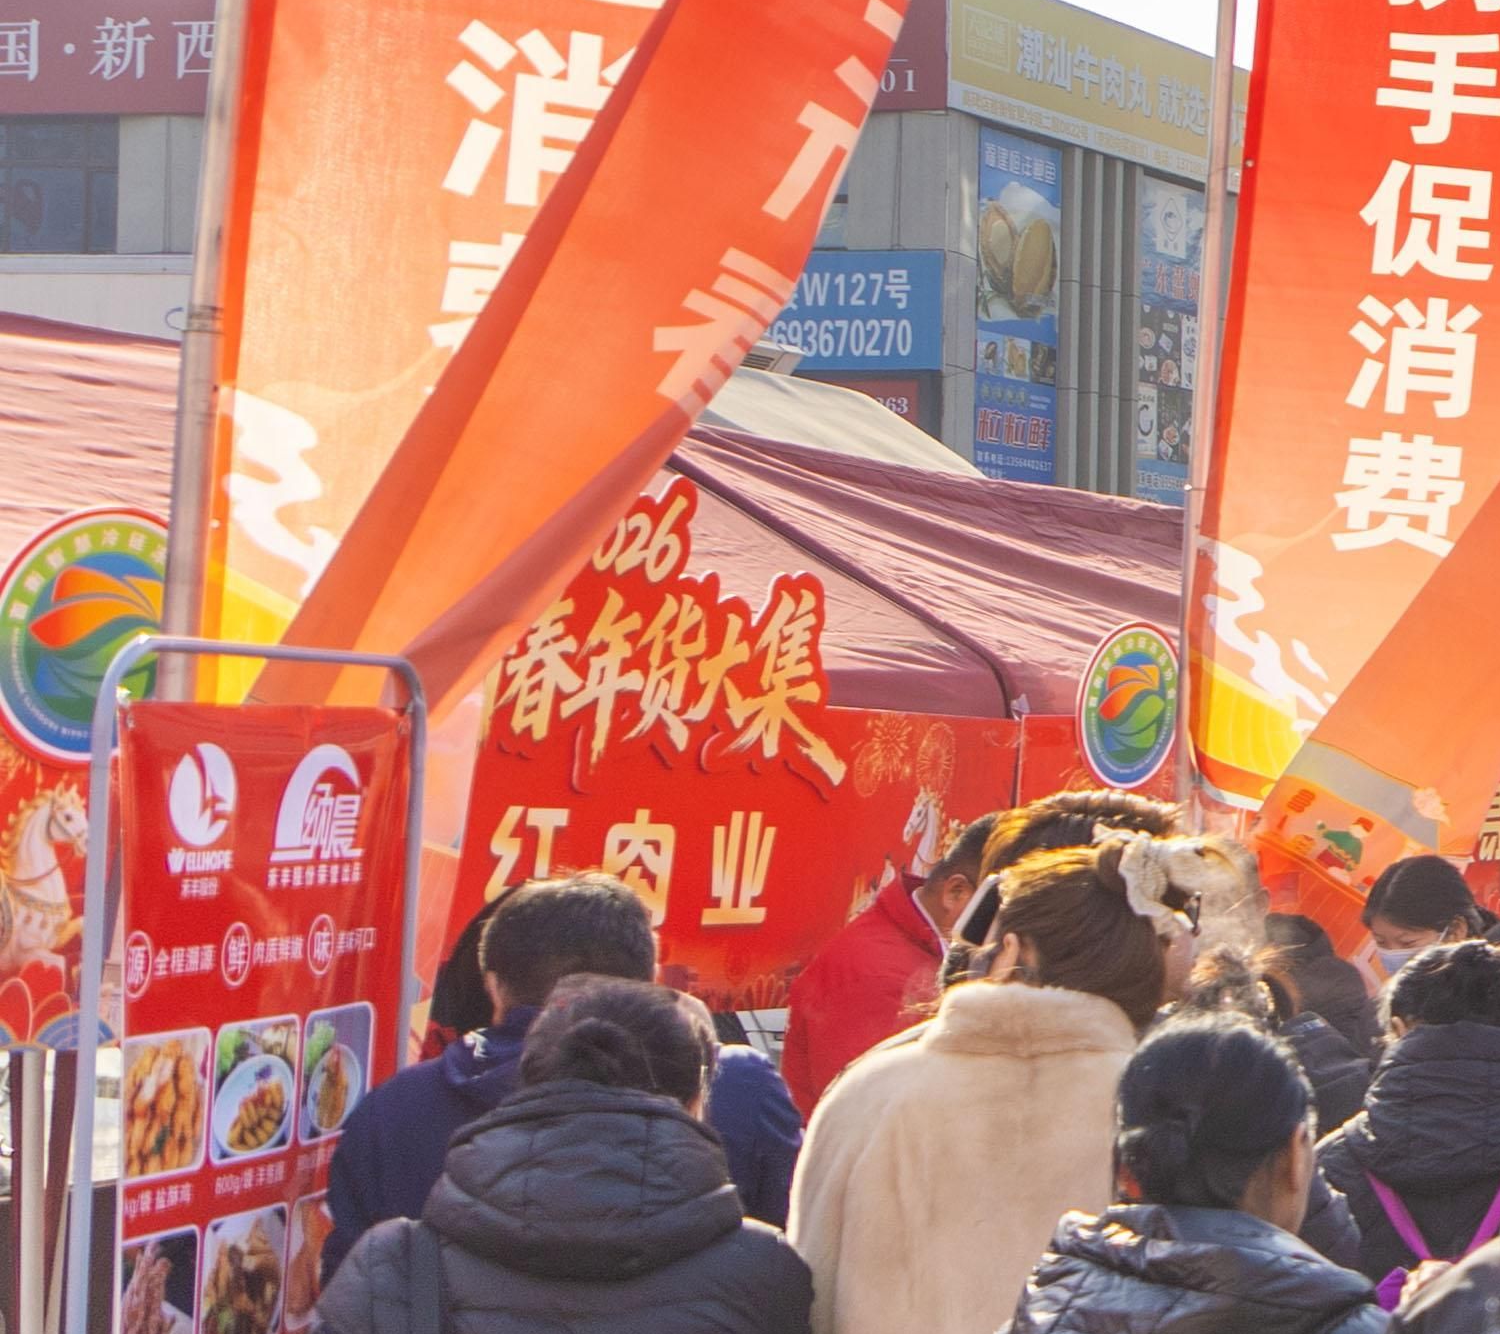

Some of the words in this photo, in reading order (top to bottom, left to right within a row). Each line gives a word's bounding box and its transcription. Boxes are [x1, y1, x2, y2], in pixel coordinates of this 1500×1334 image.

[1016, 22, 1152, 117] 潮汕牛肉丸
[764, 319, 912, 357] 693670270
[976, 407, 1052, 452] 粒粒鲜
[485, 586, 847, 785] 春年货大集
